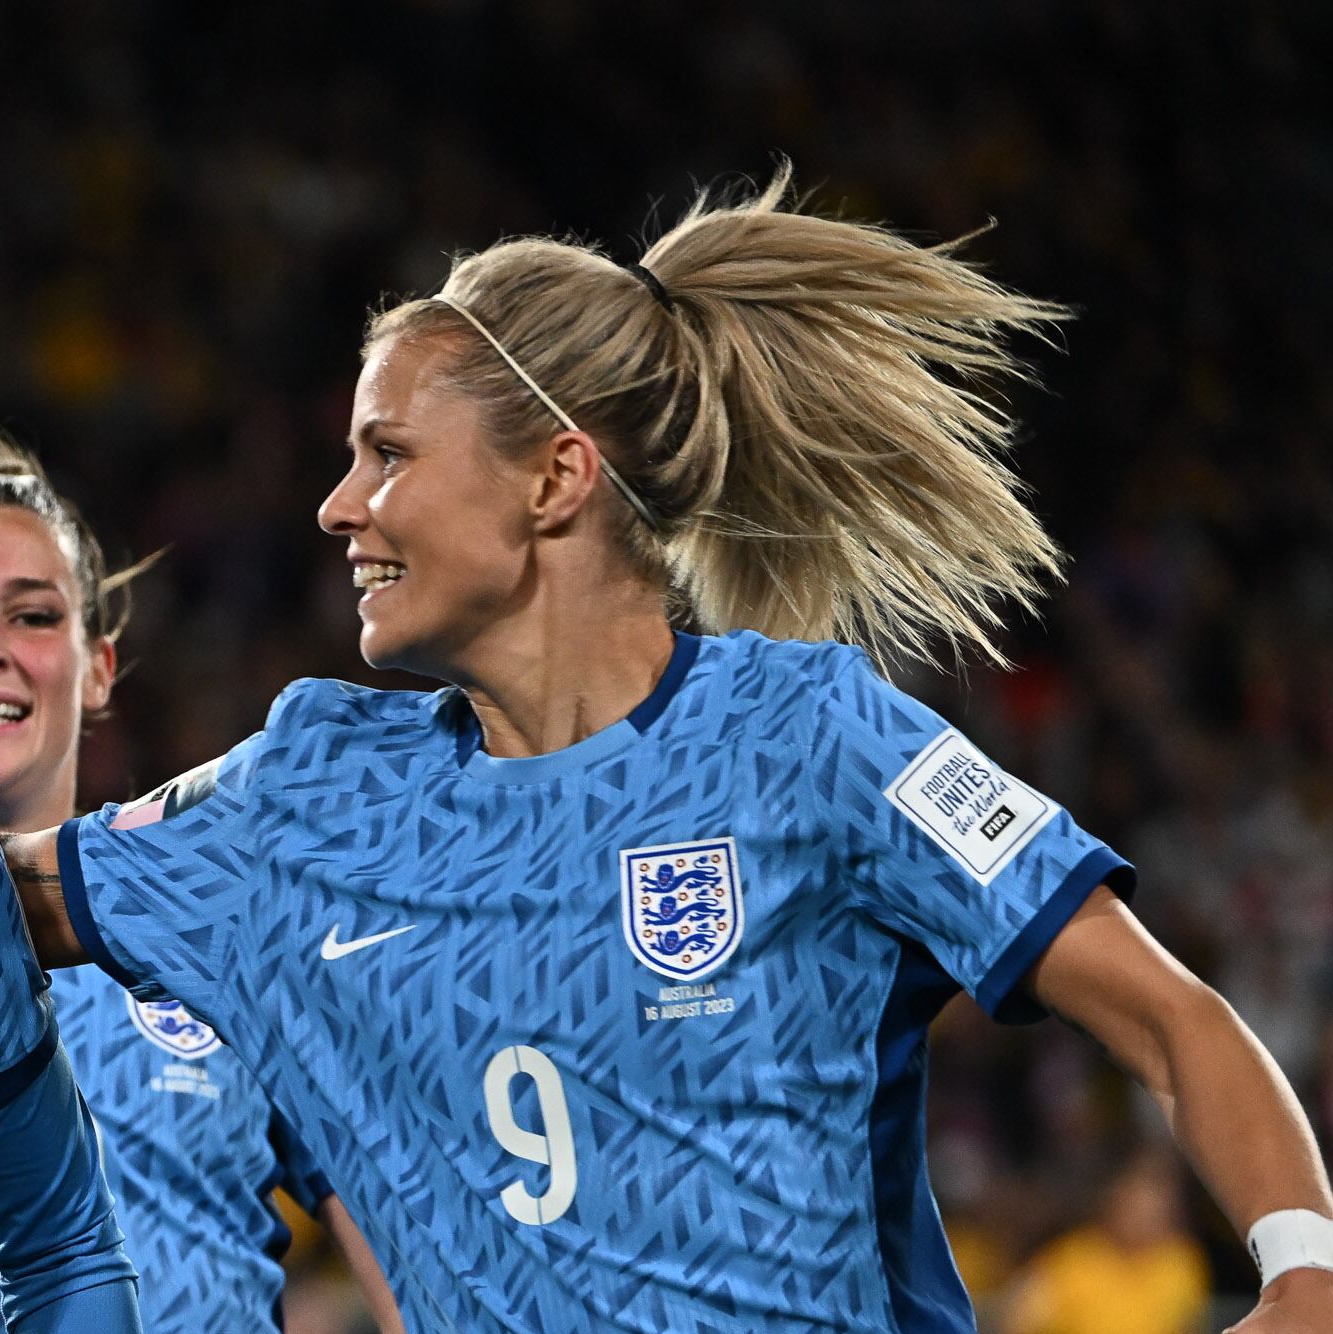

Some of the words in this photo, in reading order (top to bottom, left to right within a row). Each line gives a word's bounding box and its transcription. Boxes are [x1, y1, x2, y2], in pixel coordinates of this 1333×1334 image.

[920, 751, 972, 800] FOOTBALL
[934, 762, 990, 817] UNITES
[952, 815, 974, 836] the
[968, 775, 1011, 818] World
[982, 808, 1013, 838] FIFA
[484, 1044, 577, 1226] 9
